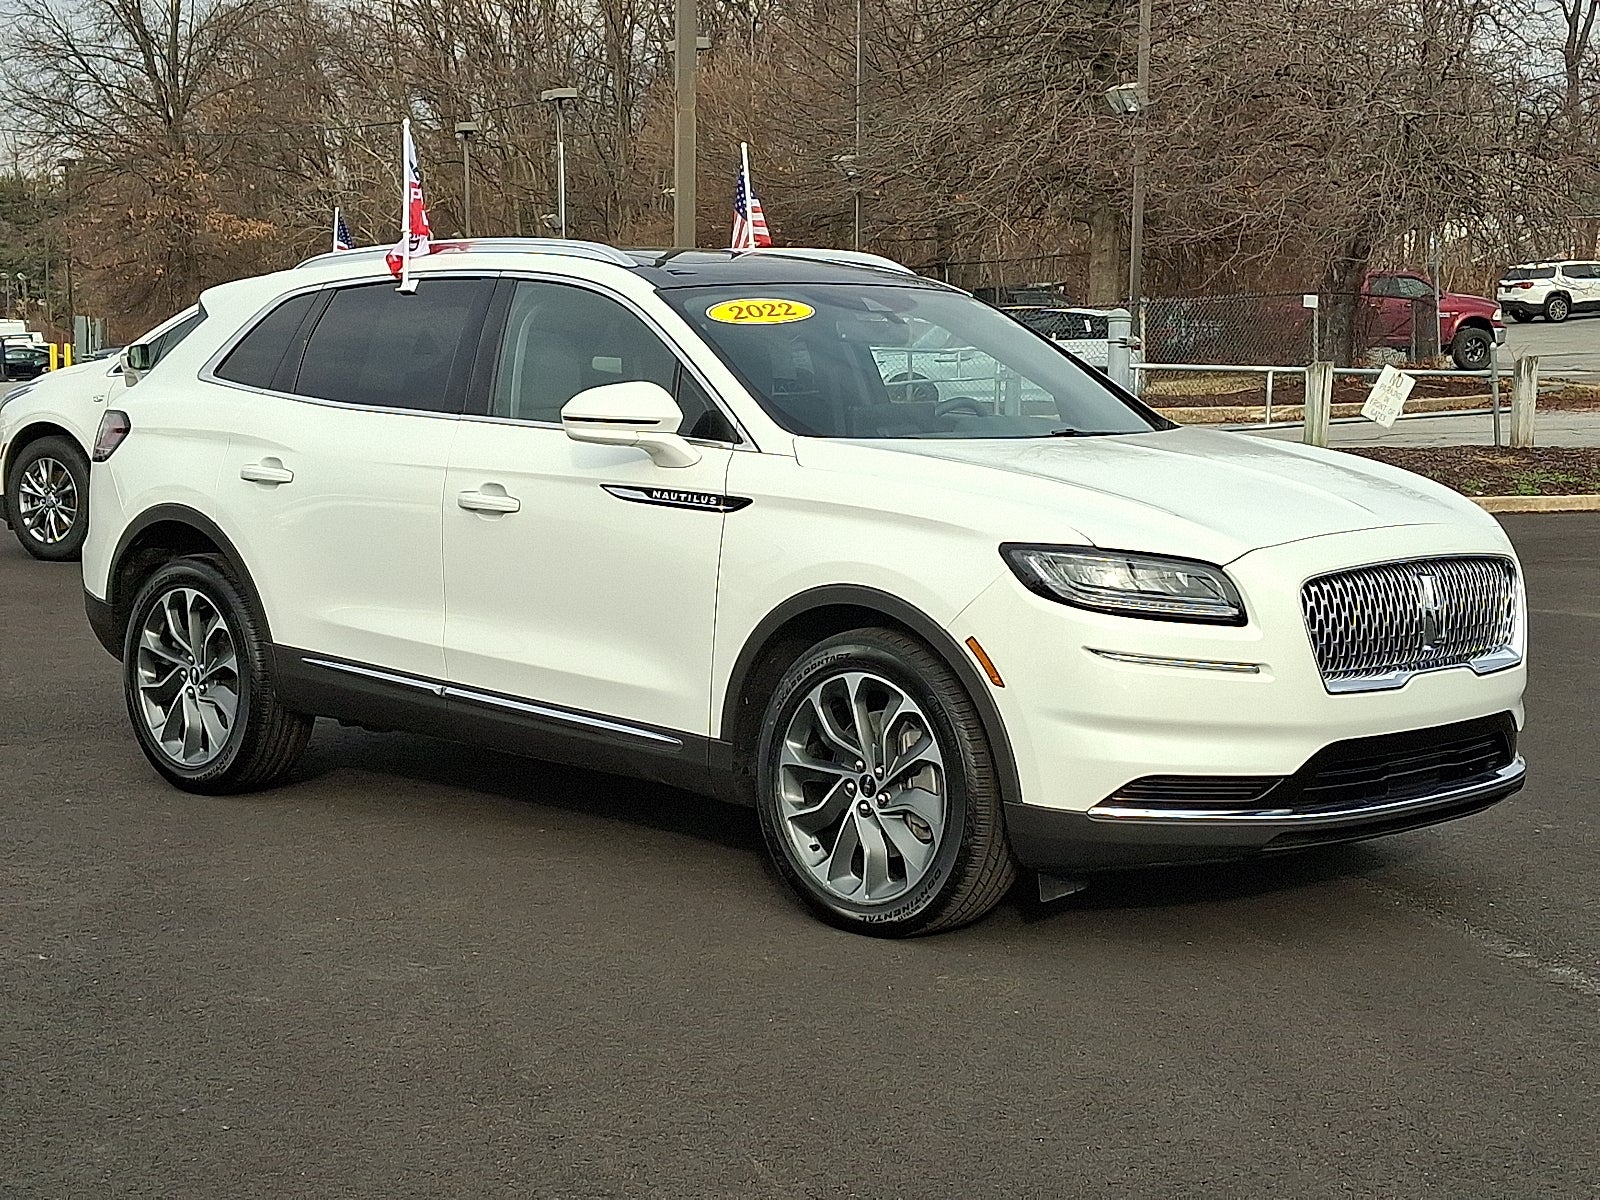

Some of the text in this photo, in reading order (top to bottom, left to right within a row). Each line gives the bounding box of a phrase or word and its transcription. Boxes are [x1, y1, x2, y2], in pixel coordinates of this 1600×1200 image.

[728, 302, 798, 320] 2022
[1389, 373, 1404, 388] NO
[652, 489, 718, 506] NAUTILUS
[859, 869, 942, 923] CONTINENTAL
